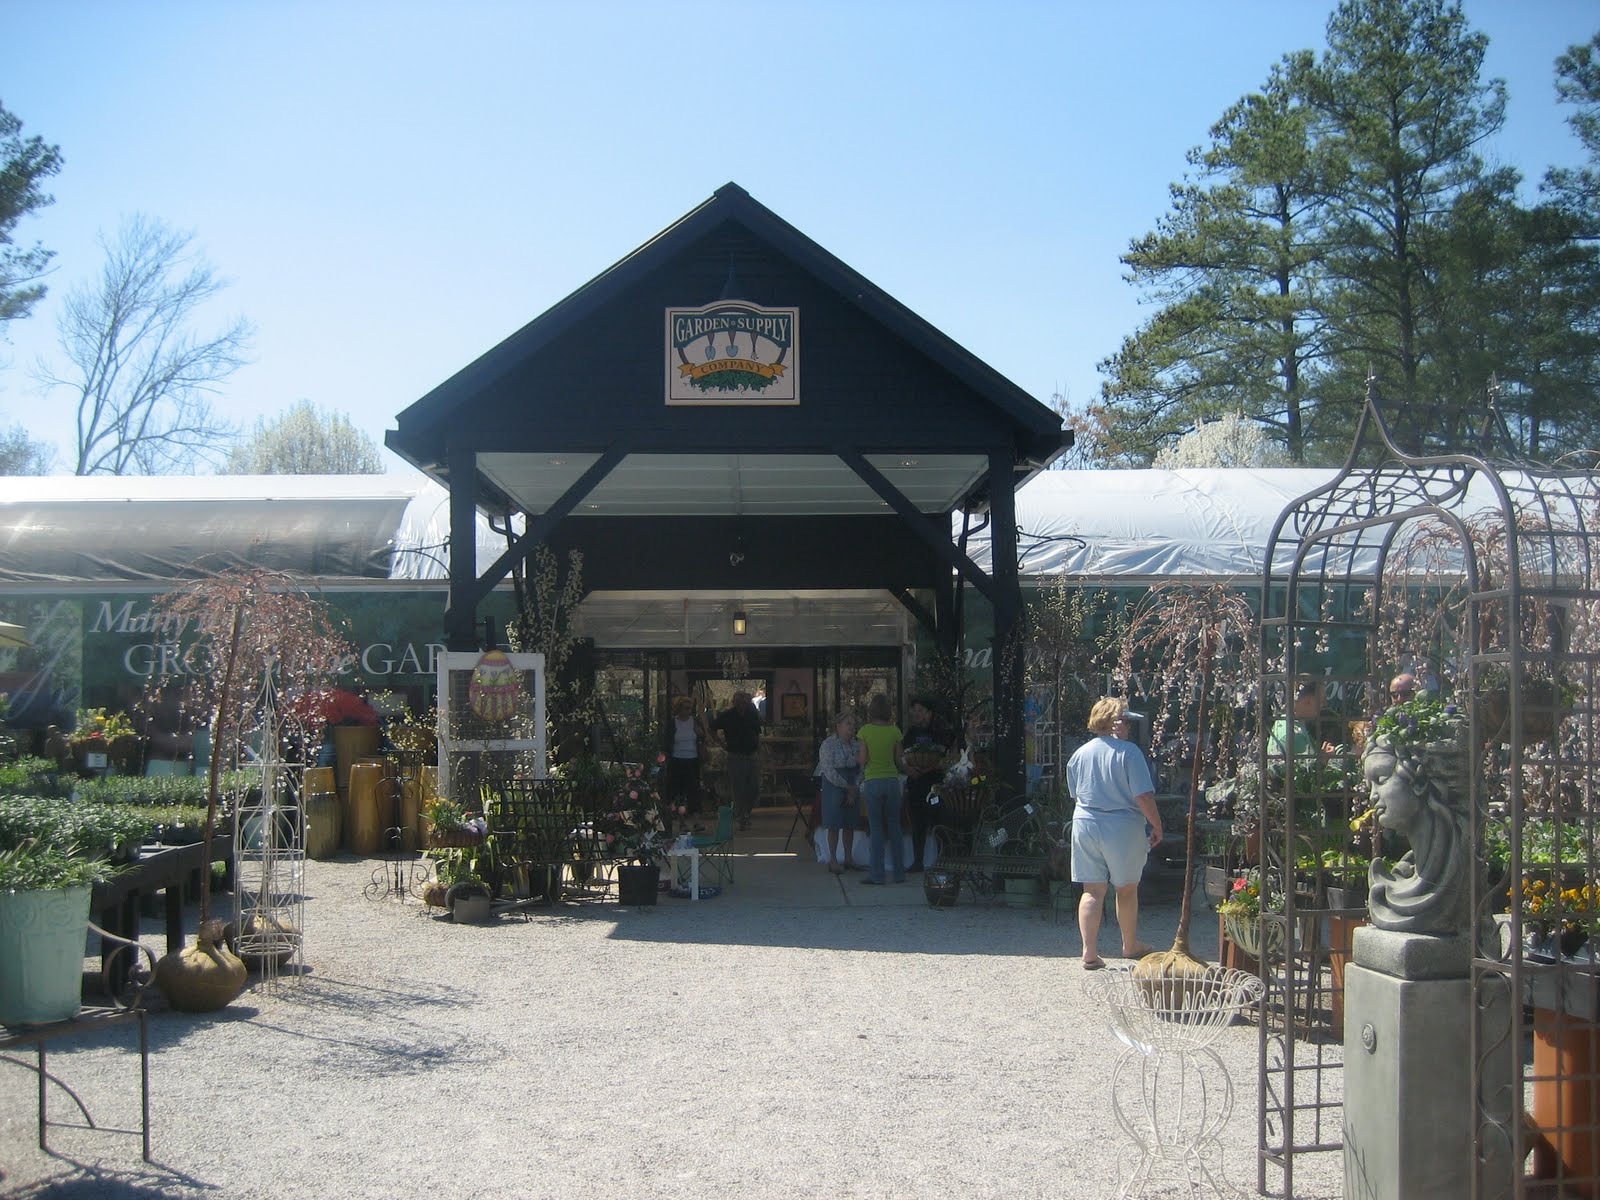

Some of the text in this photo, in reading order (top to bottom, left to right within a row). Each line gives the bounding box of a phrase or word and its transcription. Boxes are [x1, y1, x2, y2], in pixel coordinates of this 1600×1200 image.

[676, 318, 788, 342] GARDEN SUPPLY
[701, 360, 762, 374] COMPANY
